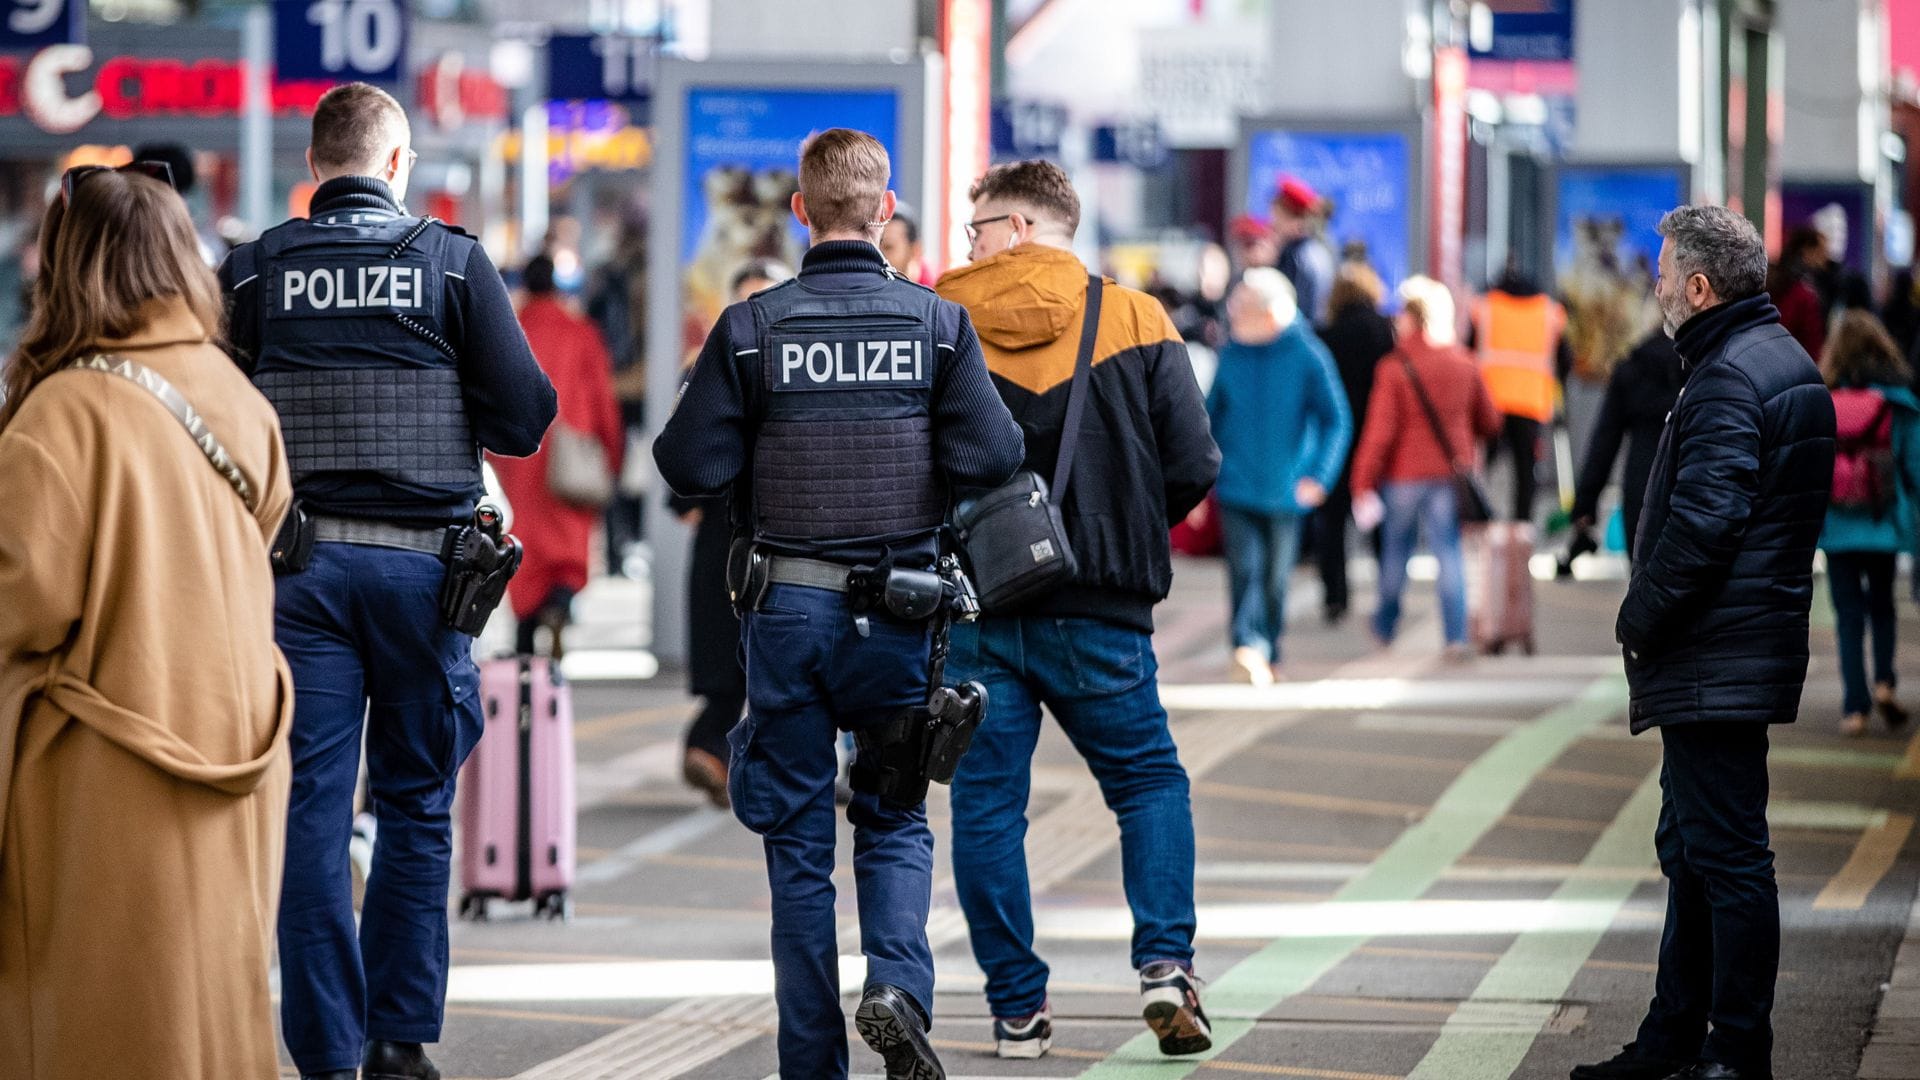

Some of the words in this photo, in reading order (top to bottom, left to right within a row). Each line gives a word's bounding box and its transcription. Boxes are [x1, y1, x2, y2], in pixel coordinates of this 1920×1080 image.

[305, 0, 400, 73] 10
[284, 266, 423, 311] POLIZEI
[782, 340, 922, 384] POLIZEI
